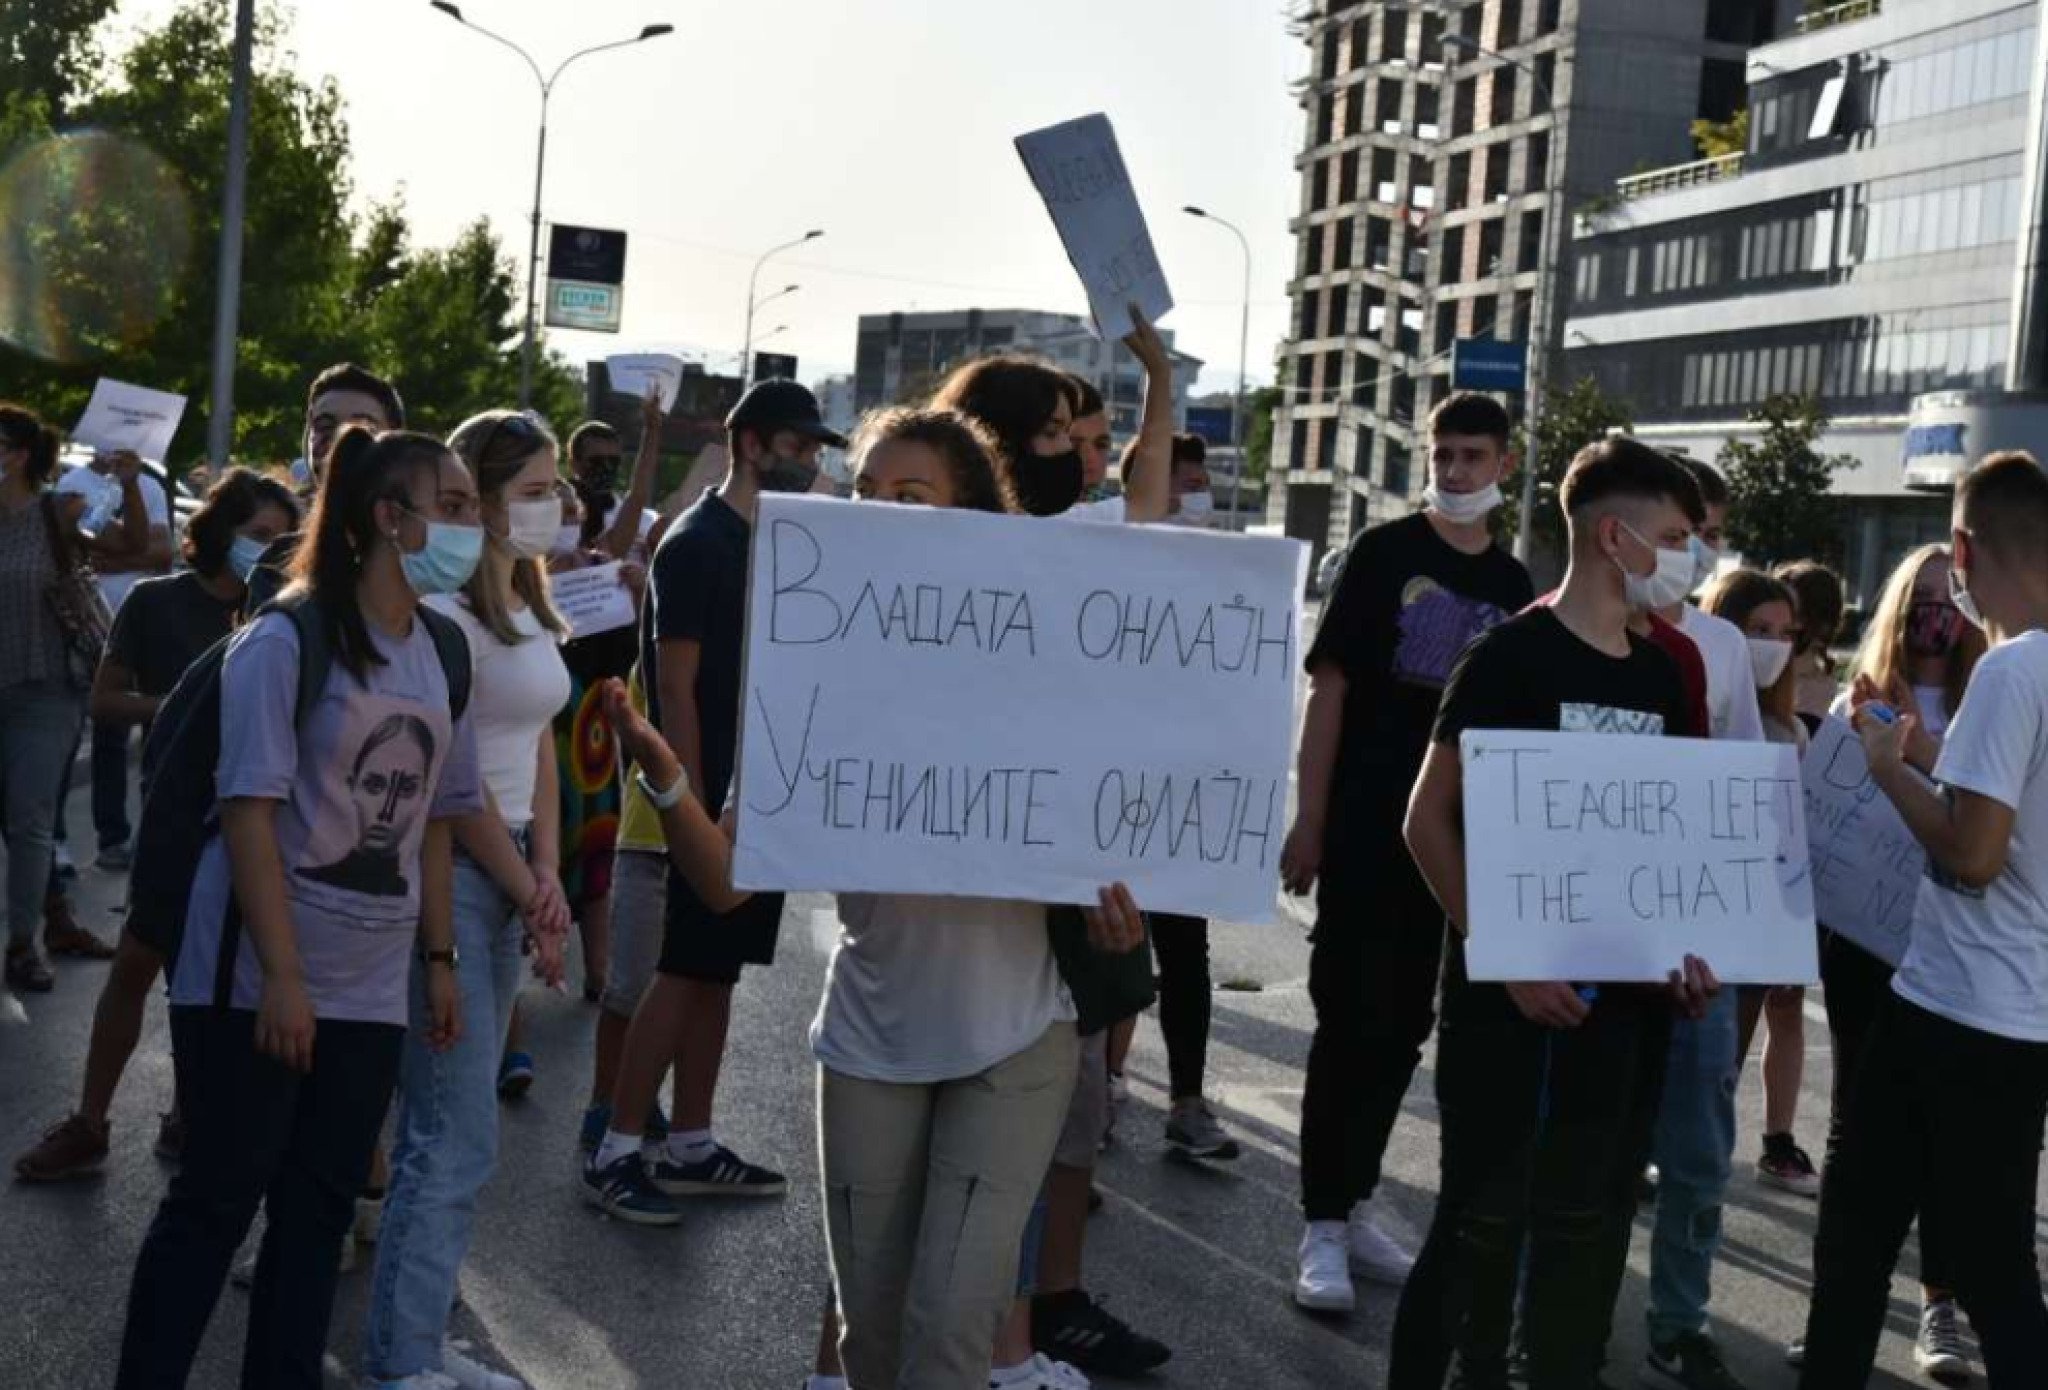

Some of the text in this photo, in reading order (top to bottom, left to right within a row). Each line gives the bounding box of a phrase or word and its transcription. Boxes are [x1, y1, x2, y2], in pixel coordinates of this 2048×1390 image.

[769, 518, 1292, 681] ВЛАДАТА ОНЛАЈН
[747, 682, 1278, 869] УЧЕНИЦИТЕ ОФЛАЈН
[1487, 748, 1799, 842] TEACHER LEFT
[1505, 858, 1767, 924] THE CHAT
